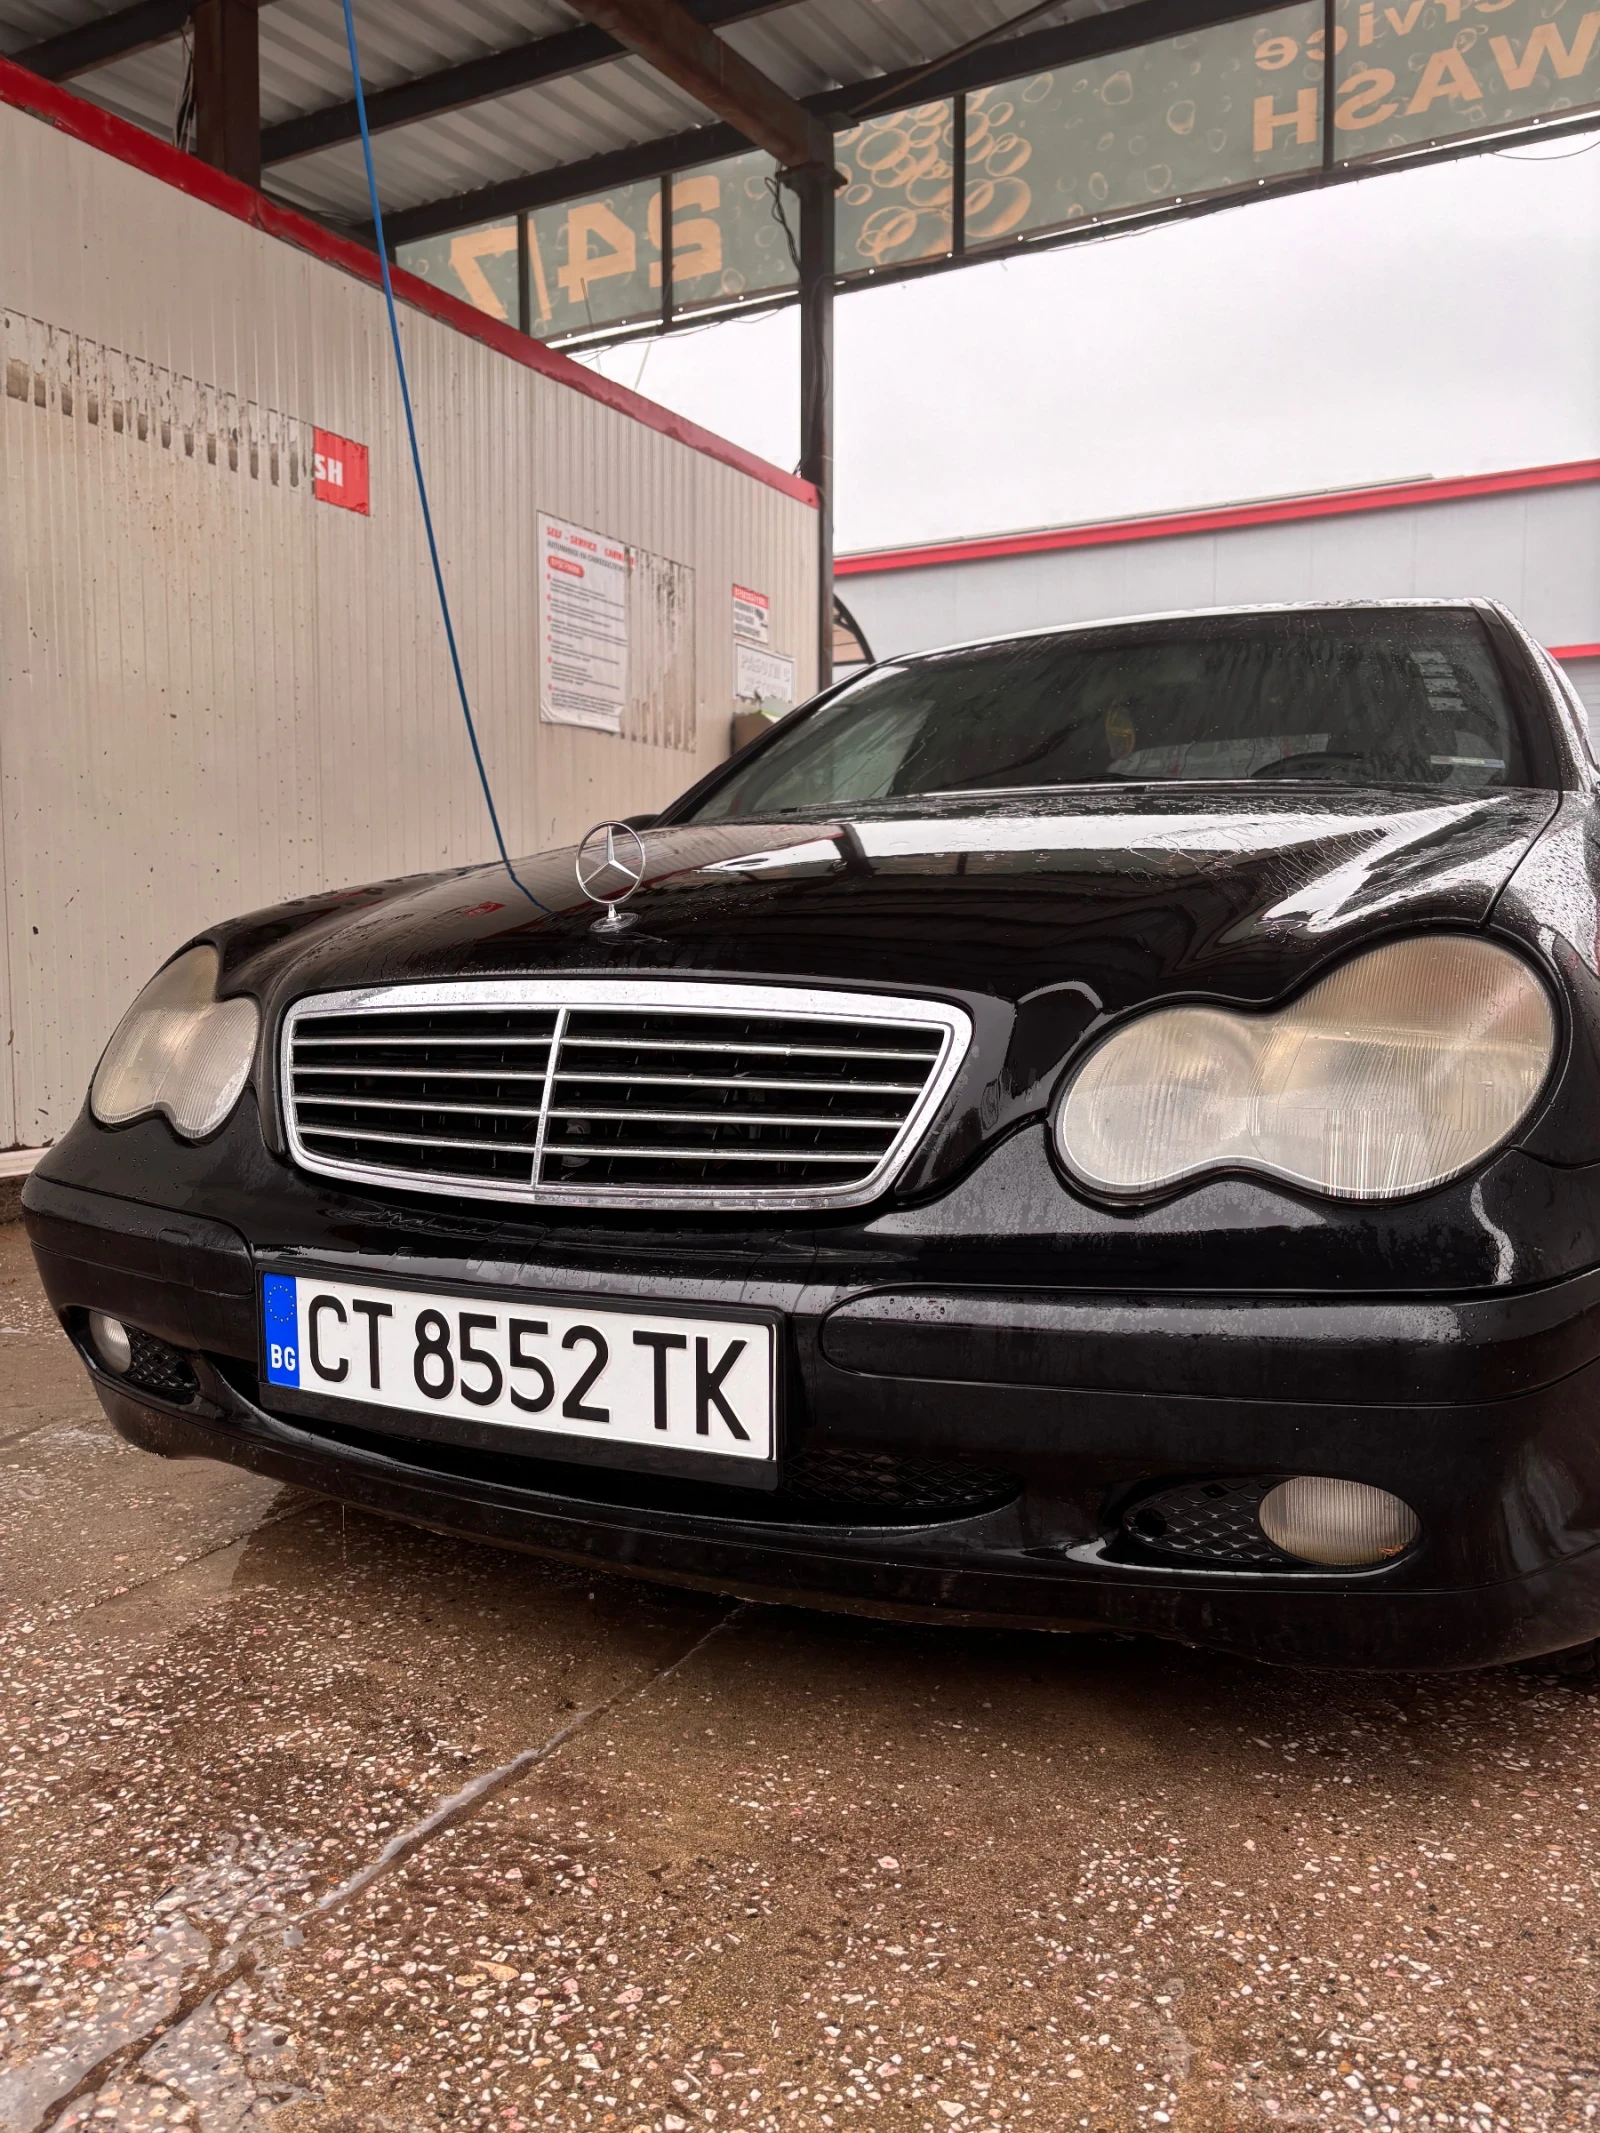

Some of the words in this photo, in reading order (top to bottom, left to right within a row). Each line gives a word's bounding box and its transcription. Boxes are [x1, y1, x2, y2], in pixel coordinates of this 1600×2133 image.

[546, 526, 562, 539] SELF
[569, 534, 598, 552] SERVICE
[270, 1343, 297, 1372] BG
[308, 1294, 394, 1390] CT
[413, 1308, 611, 1424] 8552
[632, 1329, 752, 1441] TK
